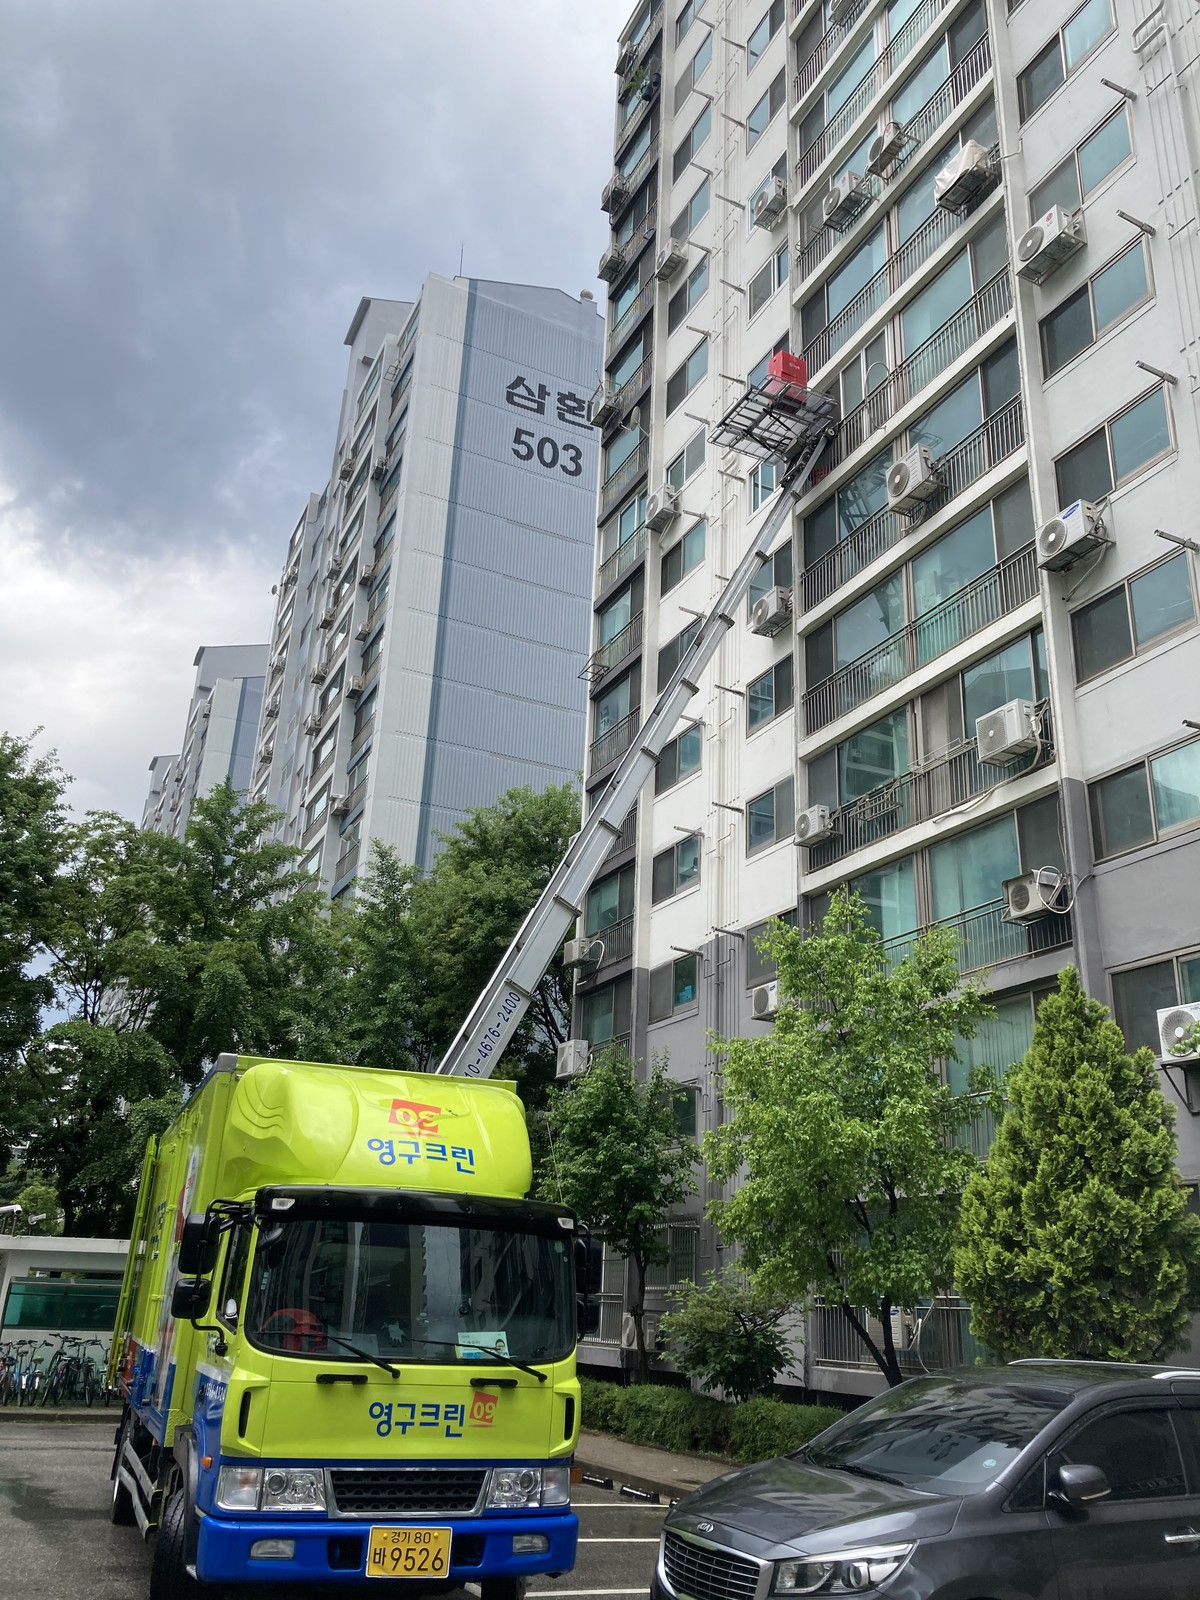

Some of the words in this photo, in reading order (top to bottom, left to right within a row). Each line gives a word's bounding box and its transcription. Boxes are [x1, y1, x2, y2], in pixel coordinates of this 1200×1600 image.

[506, 376, 594, 431] 삼환
[512, 427, 582, 477] 503
[367, 1138, 475, 1175] 영구크린
[369, 1402, 465, 1438] 영구크린
[473, 1402, 496, 1419] 09
